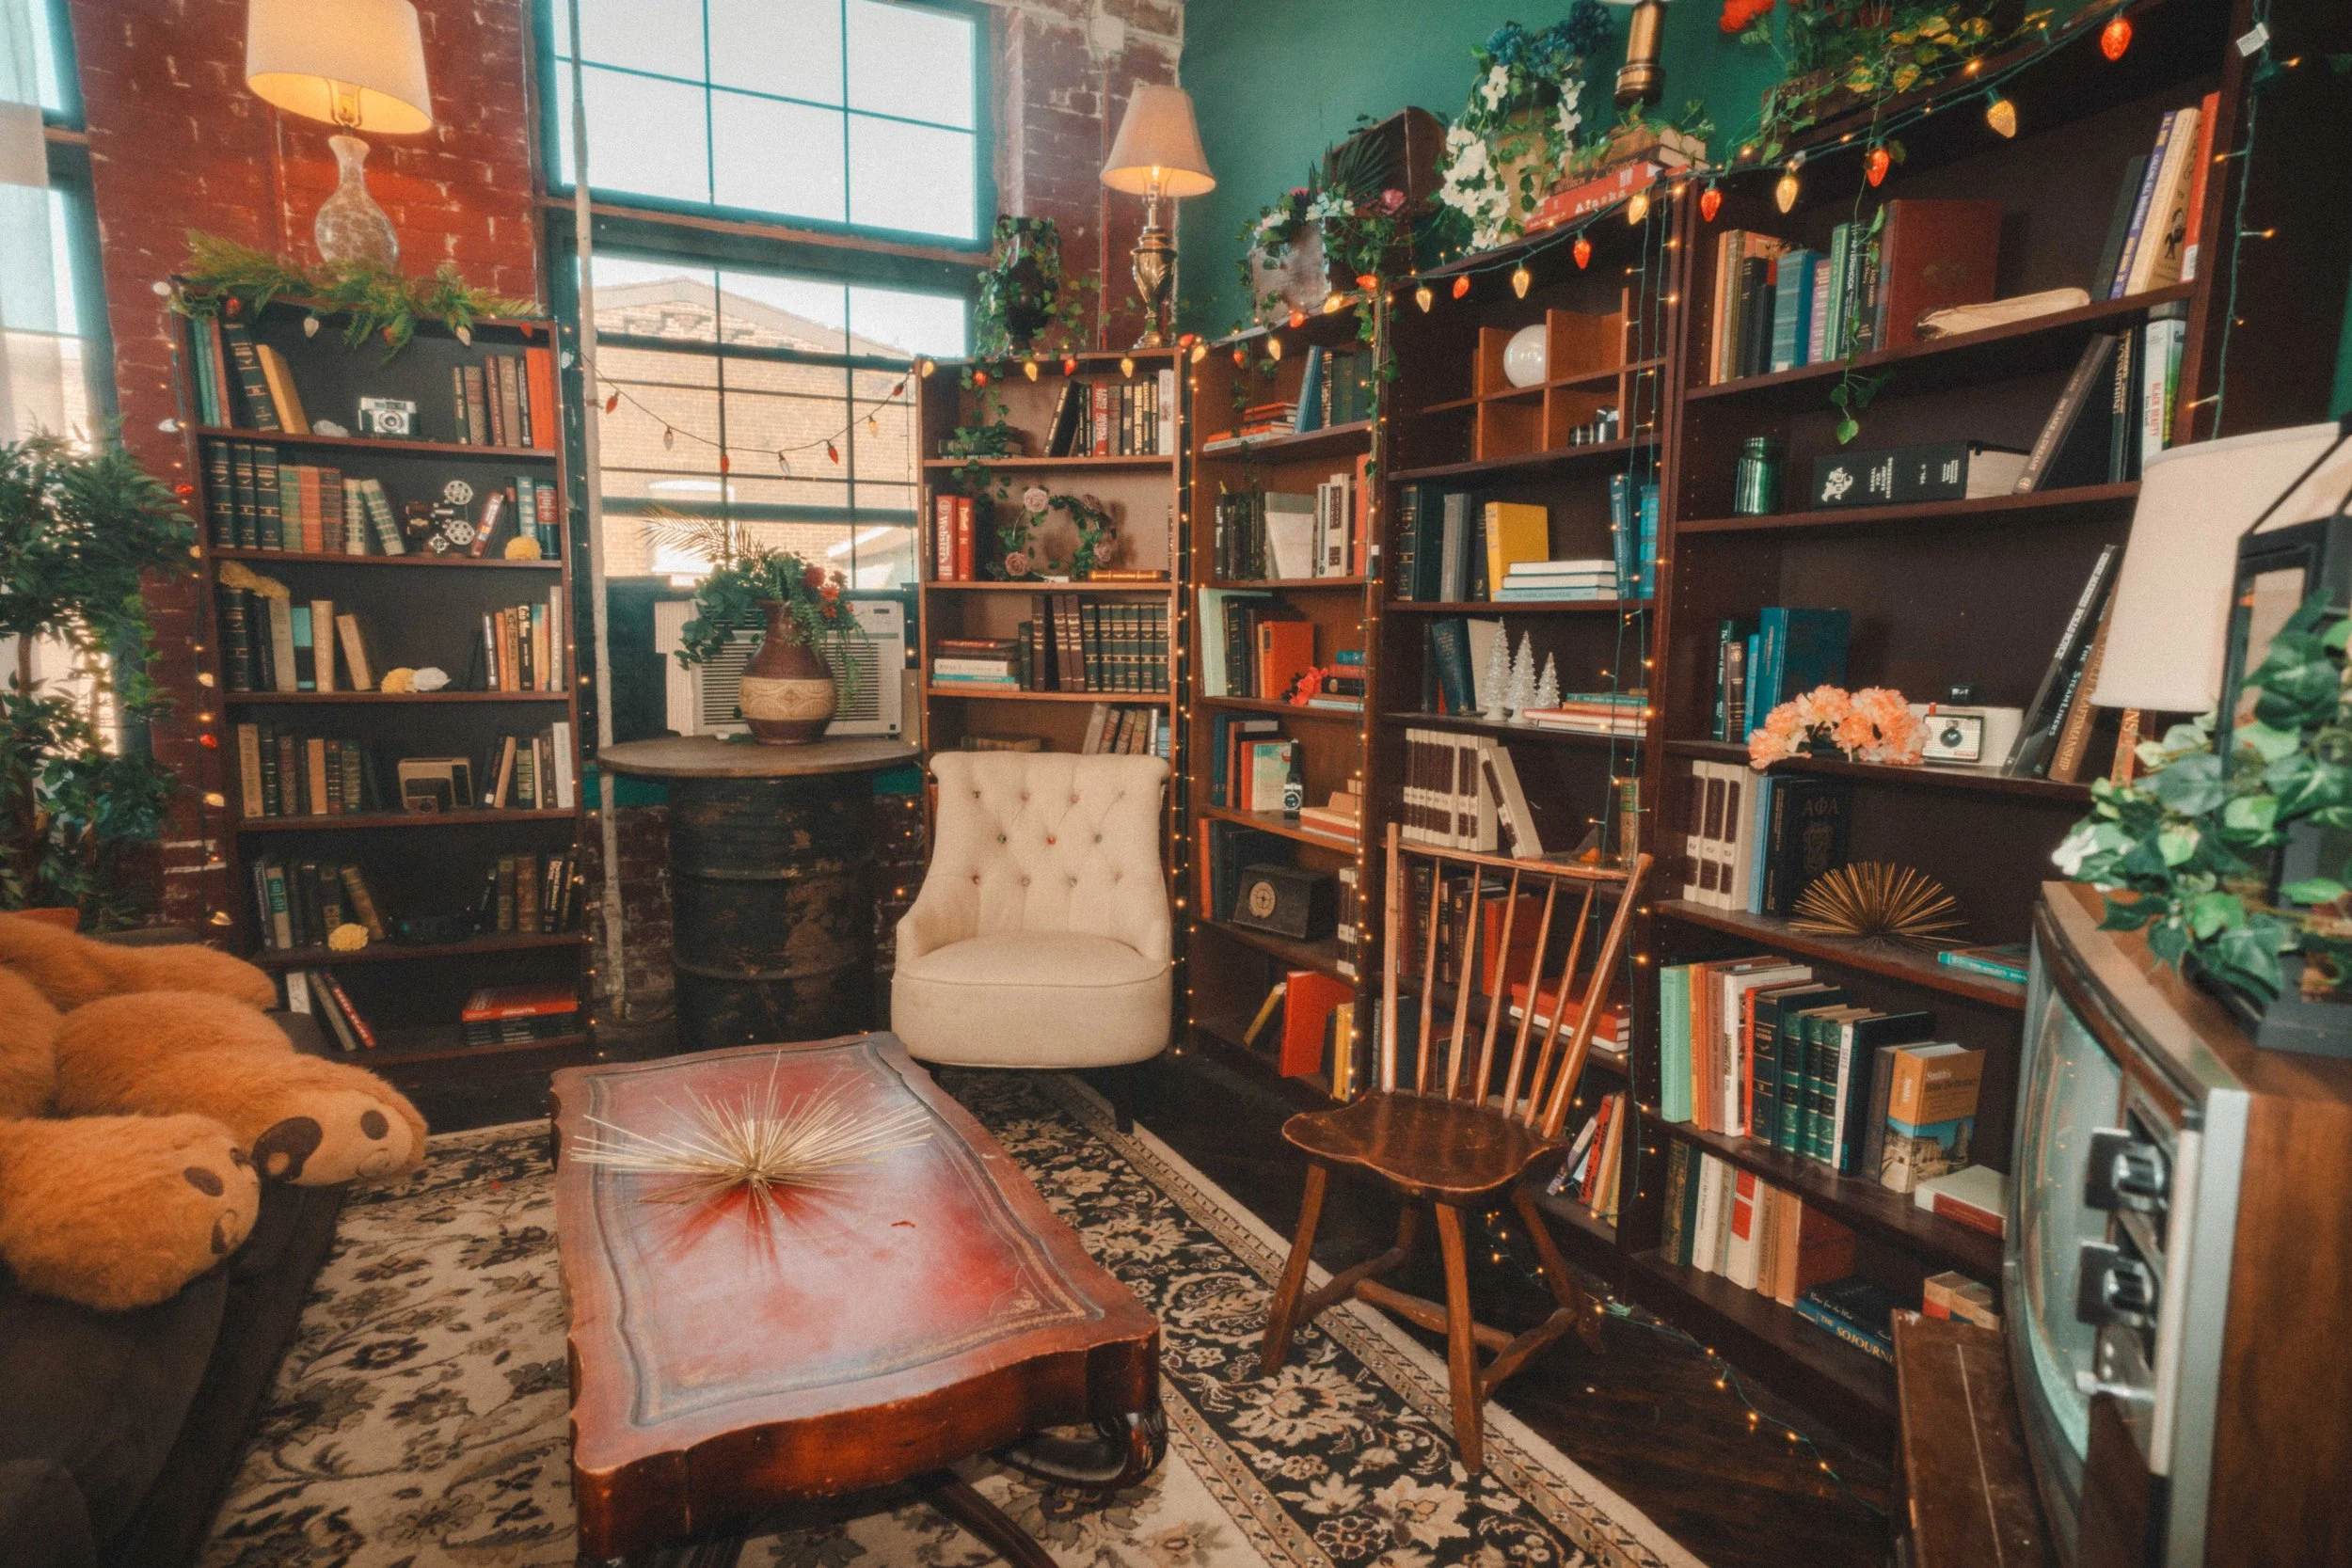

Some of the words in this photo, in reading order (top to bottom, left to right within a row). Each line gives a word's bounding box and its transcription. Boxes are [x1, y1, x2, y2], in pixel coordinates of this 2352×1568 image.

[1847, 239, 1859, 292] AFTERSHOCK
[2151, 382, 2161, 406] BLACK
[2048, 408, 2063, 430] LAKE
[2151, 408, 2159, 436] BEAUTY
[1134, 425, 1142, 449] CRITICAL
[2027, 437, 2049, 470] DREAMS
[939, 515, 949, 563] Webster's
[2054, 606, 2085, 660] ROLLS-ROYCE
[2058, 685, 2092, 773] CRAFTSMANSHIP
[1820, 1316, 1834, 1327] THE
